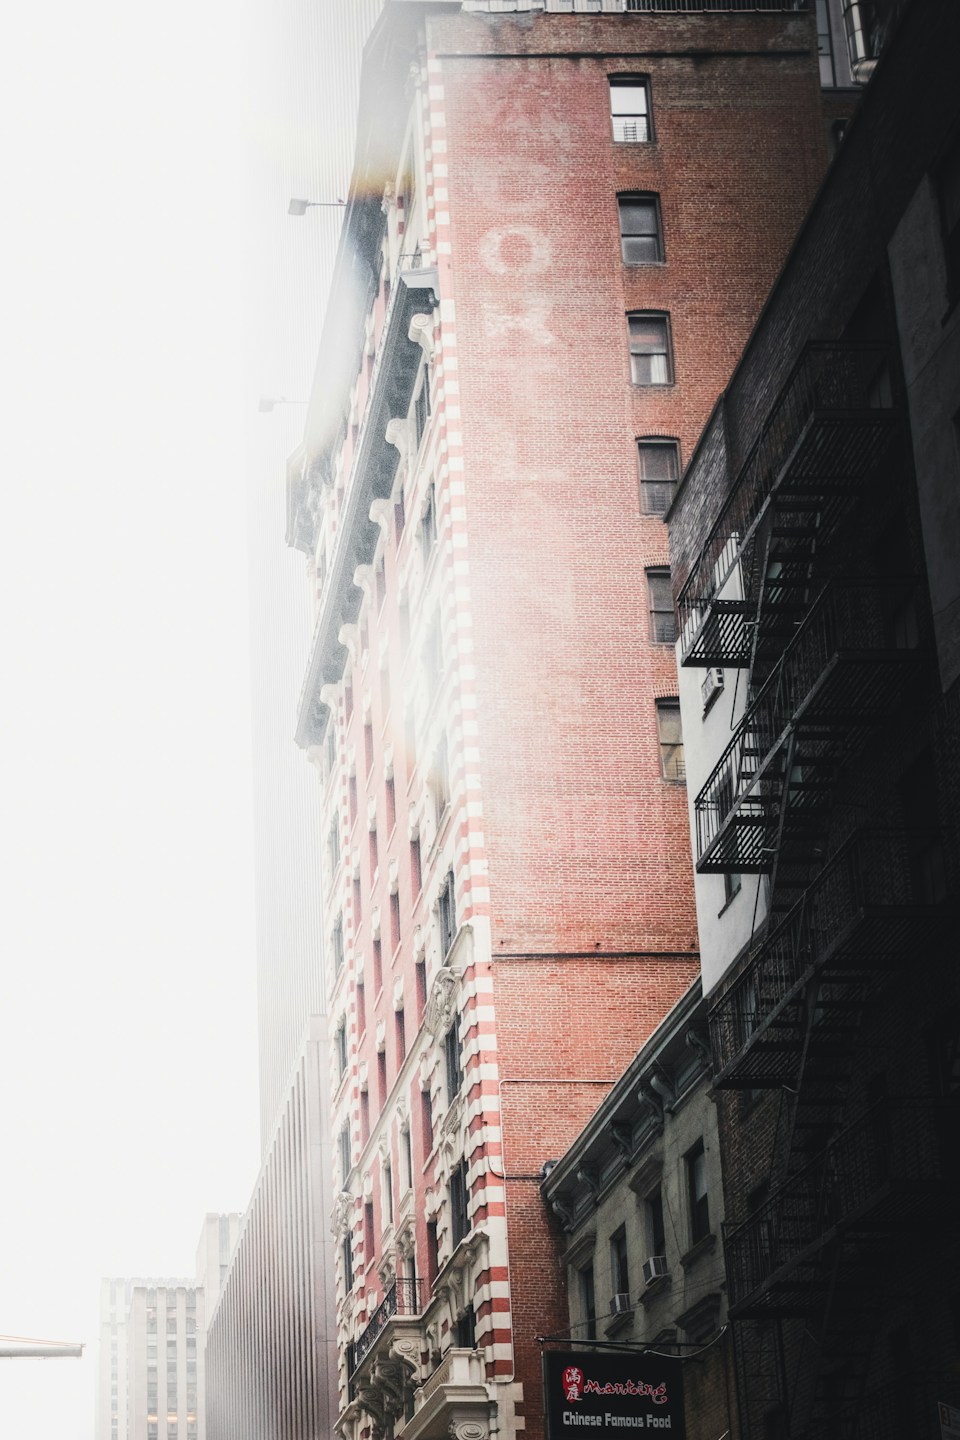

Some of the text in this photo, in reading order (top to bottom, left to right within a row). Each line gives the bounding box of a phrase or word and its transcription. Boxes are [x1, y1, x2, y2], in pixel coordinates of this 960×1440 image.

[563, 1411, 671, 1428] Chinese Famous Food
